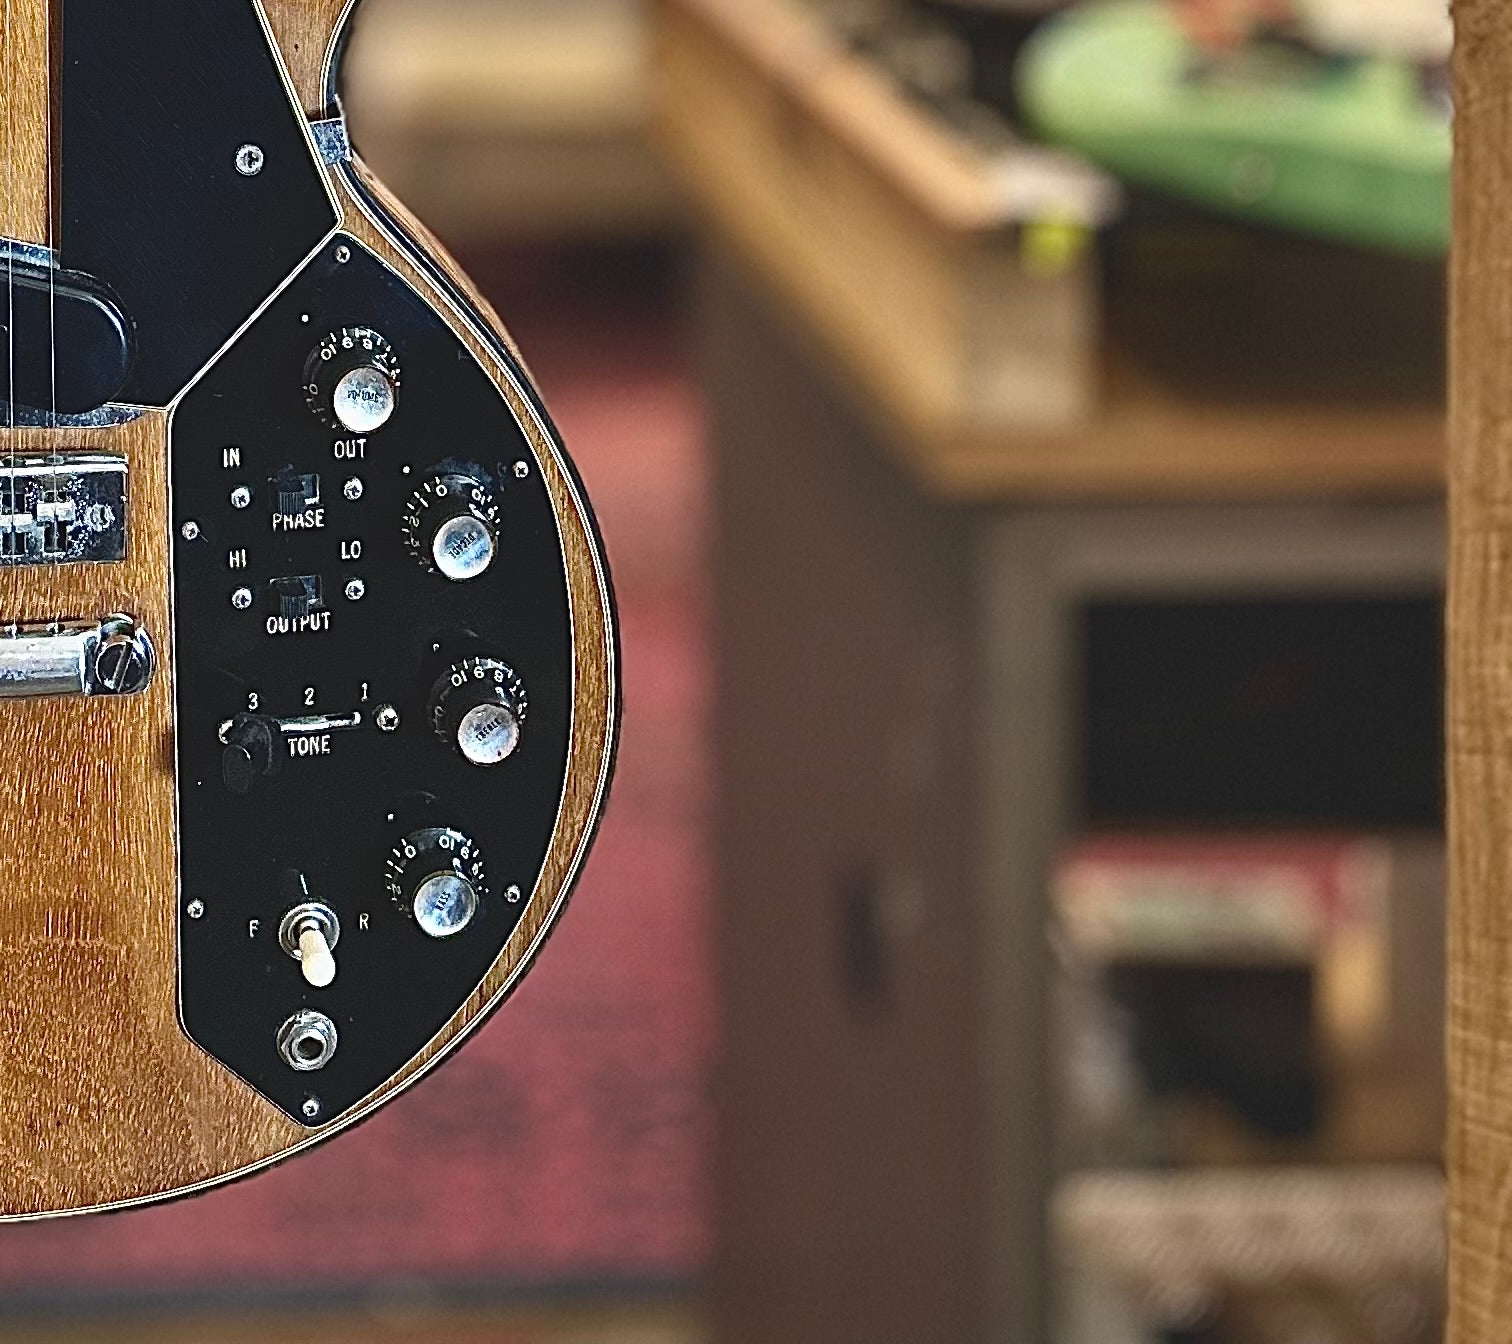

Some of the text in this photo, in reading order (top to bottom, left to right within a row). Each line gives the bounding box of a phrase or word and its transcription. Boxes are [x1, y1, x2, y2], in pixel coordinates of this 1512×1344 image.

[223, 448, 241, 468] IN
[334, 438, 367, 459] OUT
[272, 508, 325, 531] PHASE
[229, 548, 247, 568] HI
[341, 540, 362, 560] LO
[266, 611, 331, 634] OUTPUT
[248, 682, 369, 710] 3 2 1
[288, 734, 331, 757] TONE
[249, 912, 369, 938] F R
